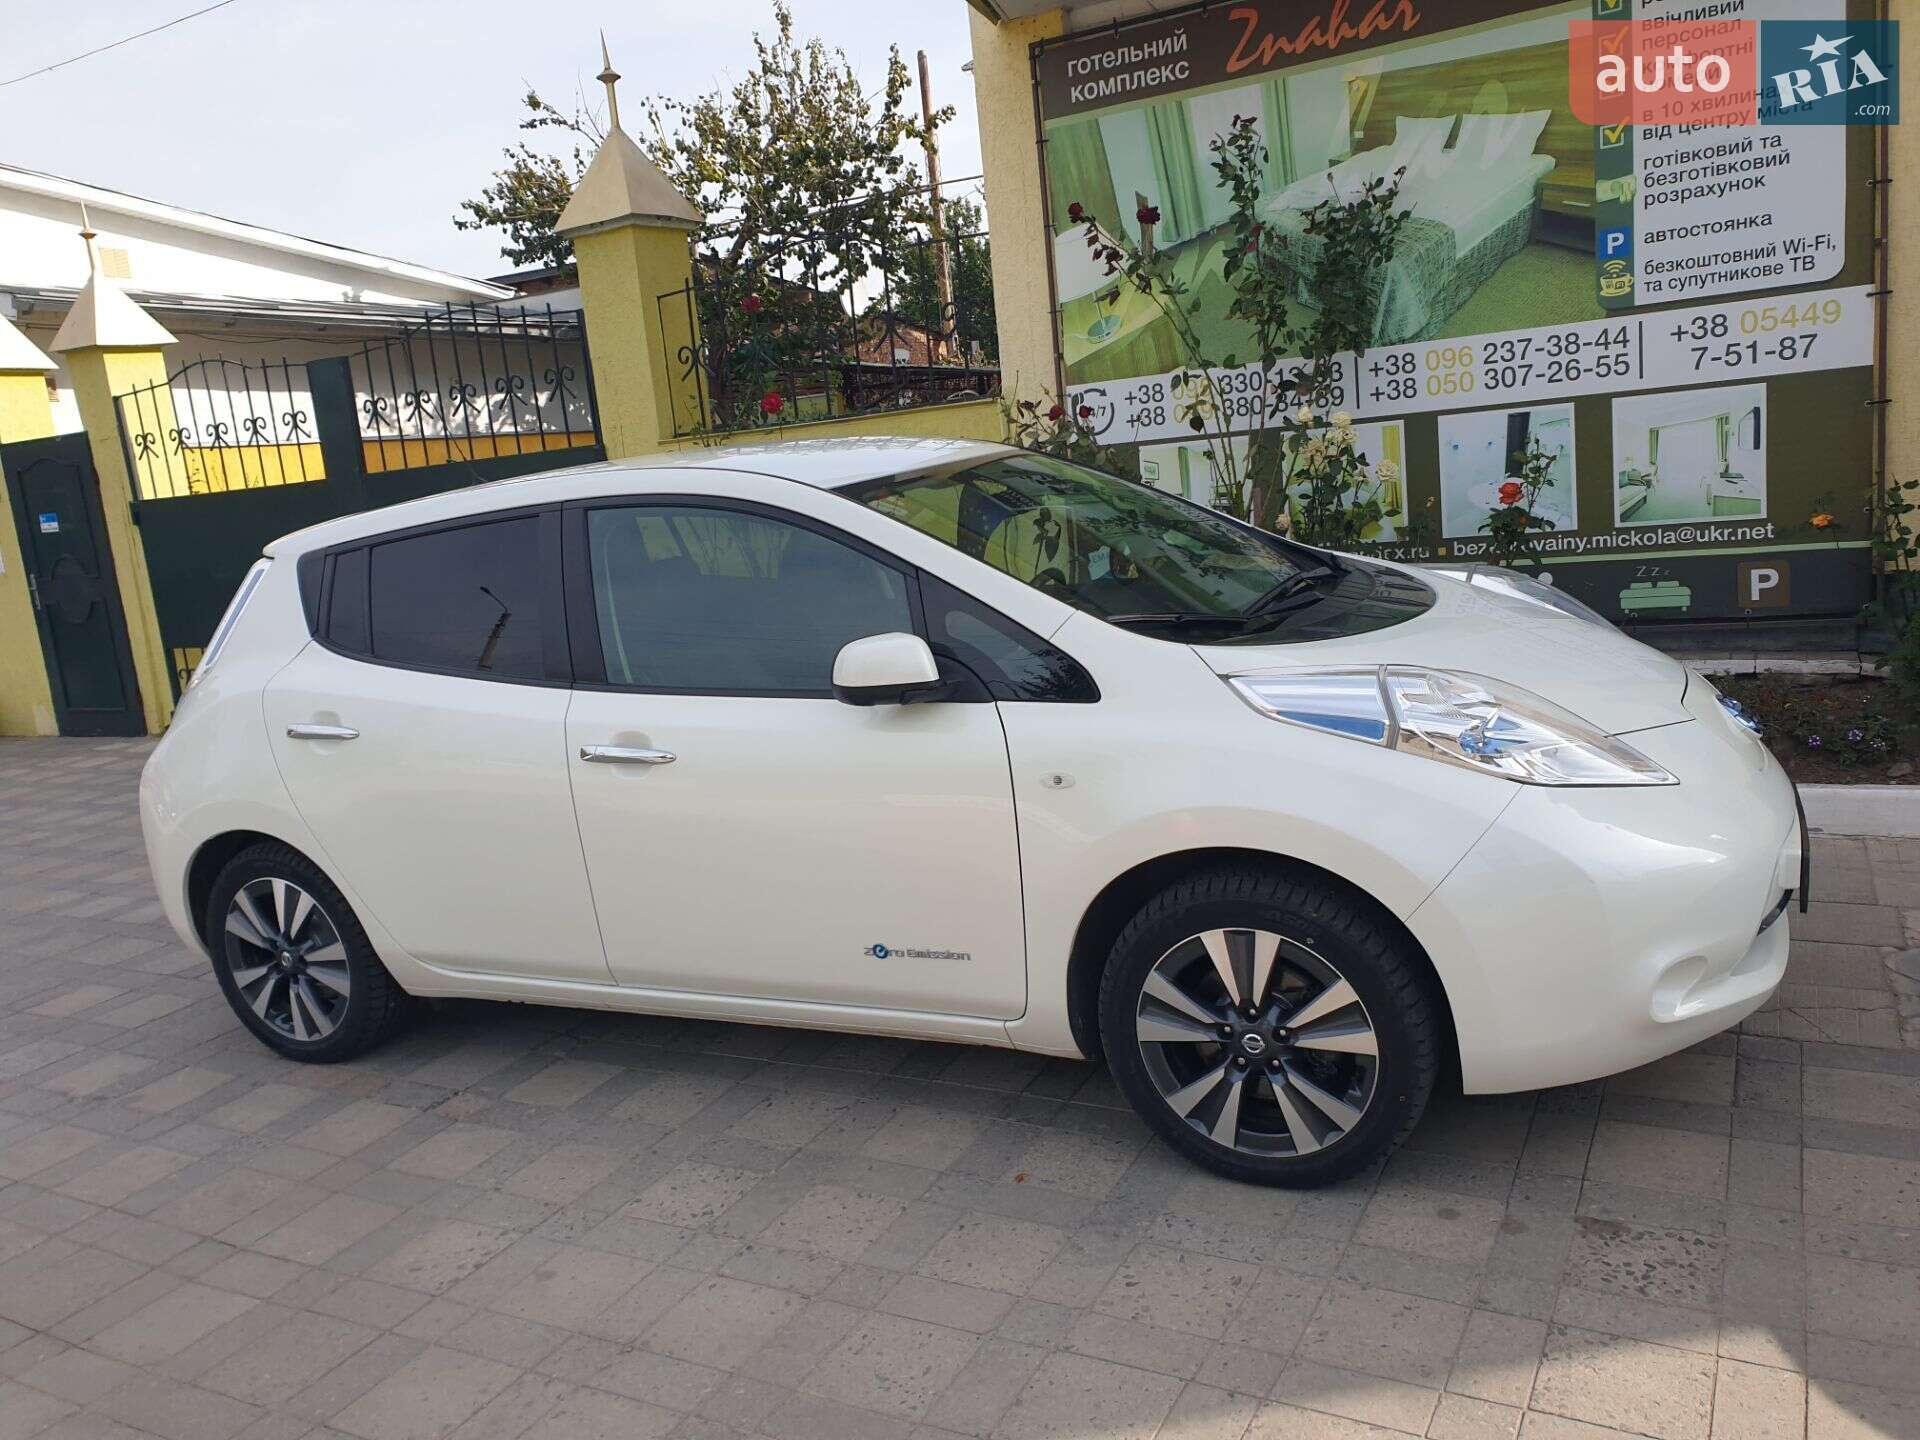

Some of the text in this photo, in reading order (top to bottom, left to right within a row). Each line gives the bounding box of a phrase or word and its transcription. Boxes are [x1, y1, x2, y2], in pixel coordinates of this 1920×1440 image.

[1068, 26, 1188, 77] готельний
[1642, 19, 1742, 51] персонал
[1070, 61, 1190, 103] комплекс
[1643, 123, 1673, 141] від
[1678, 109, 1751, 134] центру
[1661, 101, 1684, 118] 10
[1644, 134, 1783, 170] готівковий та
[1644, 151, 1791, 189] безготівковий
[1644, 174, 1767, 209] розрахунок
[1607, 232, 1624, 255] P
[1643, 212, 1773, 244] автостоянка
[1644, 233, 1837, 276] безкоштовний Wi-Fi,
[1644, 255, 1816, 293] та супутникове ТВ
[1670, 299, 1842, 343] +38 05449
[1369, 325, 1630, 378] +38 096 237-38-44
[1691, 333, 1818, 370] 7-51-87
[1124, 383, 1165, 406] +38
[1370, 353, 1630, 402] +38 050 307-26-55
[1126, 406, 1167, 429] +38
[1750, 568, 1779, 601] P
